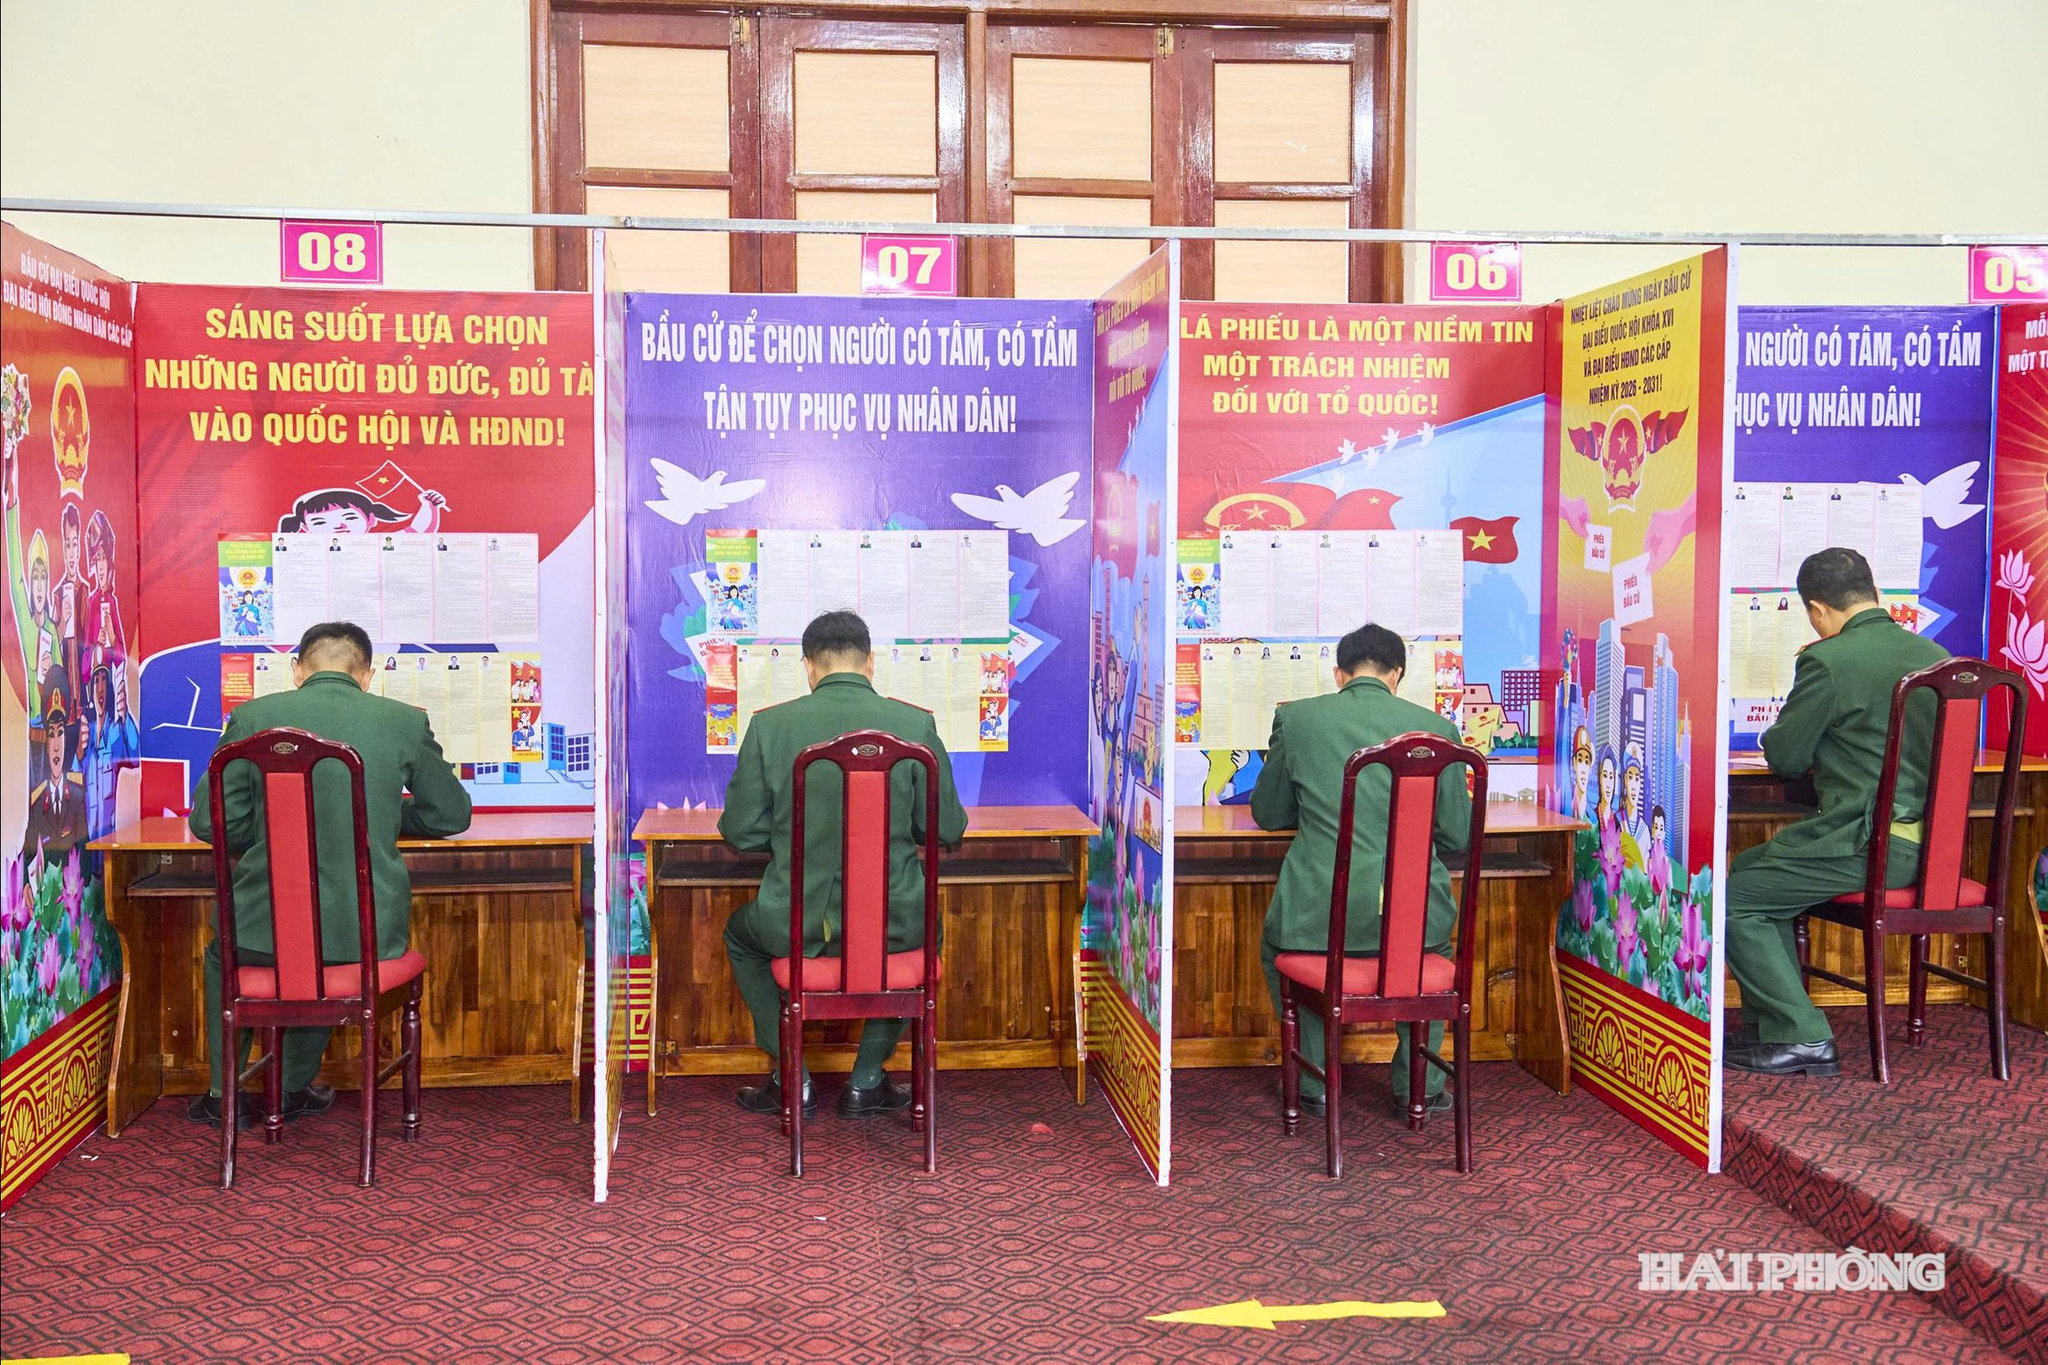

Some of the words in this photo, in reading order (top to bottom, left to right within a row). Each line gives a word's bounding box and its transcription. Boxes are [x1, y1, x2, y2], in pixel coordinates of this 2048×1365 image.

[298, 231, 366, 273] 08
[878, 245, 942, 289] 07
[1446, 252, 1507, 291] 06
[1643, 278, 1663, 303] NGÀY
[1680, 264, 1693, 292] CỬ
[1984, 256, 2046, 294] 05
[206, 302, 294, 340] SÁNG
[304, 301, 385, 342] SUỐT
[395, 311, 454, 350] LỰA
[463, 314, 548, 351] CHỌN
[641, 309, 686, 363] BẦU
[692, 310, 724, 363] CỬ
[727, 308, 757, 363] ĐỂ
[763, 323, 823, 372] CHỌN
[829, 316, 896, 365] NGƯỜI
[903, 319, 932, 366] CÓ
[937, 319, 990, 371] TÂM,
[997, 320, 1026, 367] CÓ
[1031, 315, 1078, 367] TẦM
[1180, 313, 1213, 339] LÁ
[1221, 312, 1299, 341] PHIẾU
[1308, 315, 1340, 342] LÀ
[1349, 316, 1406, 346] MỘT
[1413, 315, 1483, 343] NIỀM
[1491, 321, 1534, 343] TIN
[1582, 331, 1594, 352] ĐẠI
[1594, 321, 1609, 347] BIỂU
[1609, 316, 1628, 345] QUỐC
[1628, 314, 1639, 340] HỘI
[1641, 310, 1661, 334] KHÓA
[1662, 308, 1675, 330] XVI
[1745, 323, 1809, 367] NGƯỜI
[1814, 324, 1842, 367] CÓ
[1848, 324, 1898, 371] TÂM,
[1904, 325, 1932, 367] CÓ
[1937, 320, 1982, 366] TẦM
[145, 353, 258, 391] NHỮNG
[268, 356, 366, 393] NGƯỜI
[375, 354, 418, 394] ĐỦ
[427, 359, 500, 399] ĐỨC,
[508, 357, 550, 396] ĐỦ
[559, 361, 594, 396] TÀ
[1203, 350, 1261, 382] MỘT
[1269, 352, 1355, 378] TRÁCH
[1363, 353, 1450, 383] NHIỆM
[1592, 357, 1604, 379] ĐẠI
[1604, 347, 1620, 373] BIỂU
[1620, 348, 1640, 370] HĐND
[1640, 342, 1655, 365] CÁC
[2008, 349, 2037, 376] MỘT
[1212, 384, 1258, 414] ĐỐI
[1266, 388, 1309, 414] VỚI
[1317, 384, 1350, 414] TỔ
[1358, 386, 1439, 417] QUỐC!
[1620, 378, 1637, 399] 2026
[1642, 373, 1663, 395] 2031!
[189, 405, 253, 443] VÀO
[263, 403, 348, 446] QUỐC
[358, 409, 410, 451] HỘI
[419, 409, 461, 445] VÀ
[469, 416, 565, 446] HĐND!
[703, 383, 747, 439] TẬN
[752, 392, 793, 439] TỤY
[799, 392, 857, 440] PHỤC
[863, 393, 891, 441] VỤ
[897, 386, 958, 432] NHÂN
[964, 386, 1017, 433] DÂN!
[1734, 392, 1770, 435] HỤC
[1776, 393, 1803, 435] VỤ
[1808, 385, 1866, 427] NHÂN
[1871, 385, 1921, 427] DÂN!
